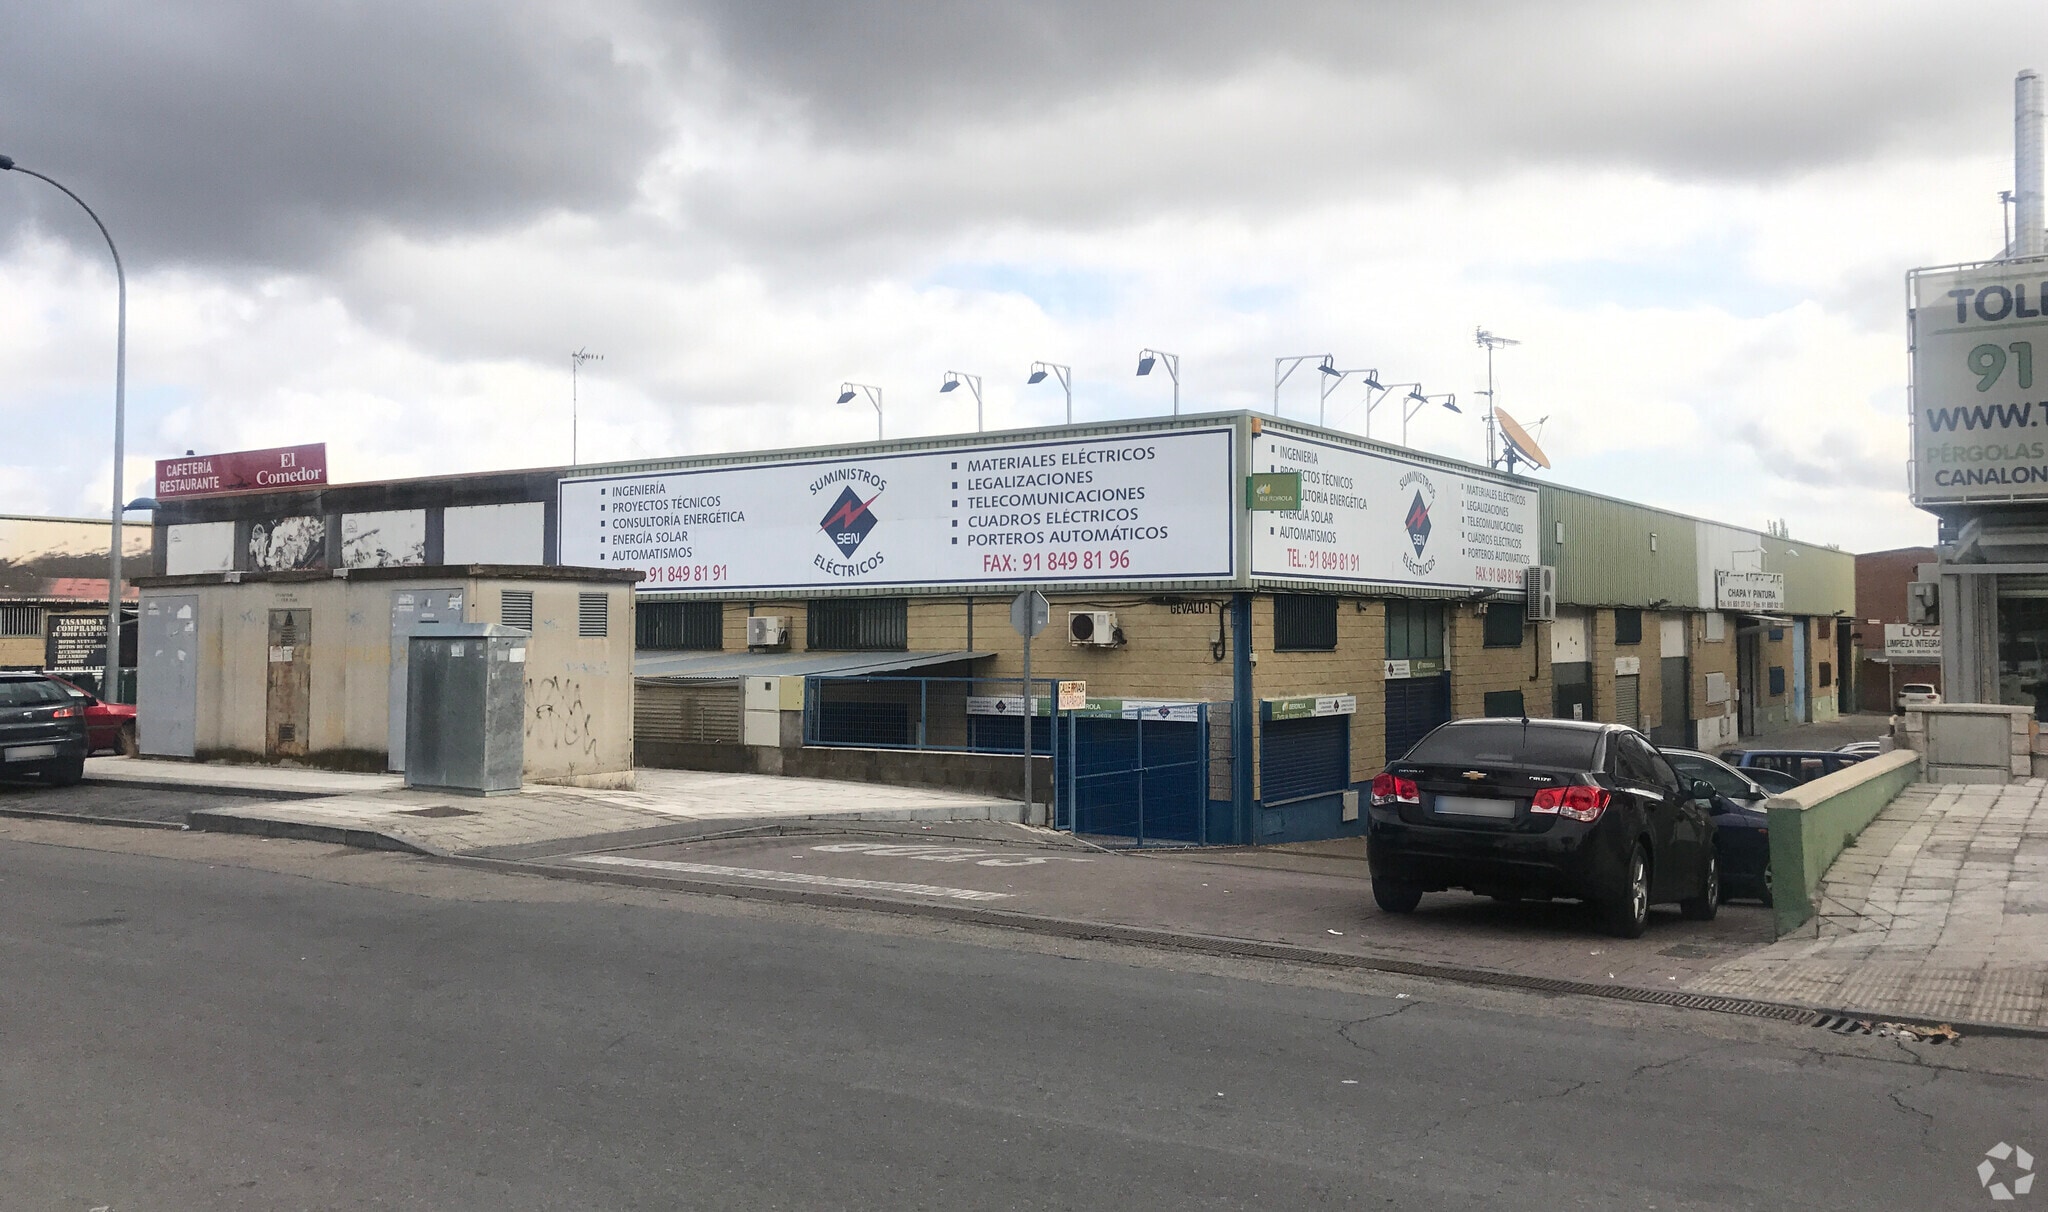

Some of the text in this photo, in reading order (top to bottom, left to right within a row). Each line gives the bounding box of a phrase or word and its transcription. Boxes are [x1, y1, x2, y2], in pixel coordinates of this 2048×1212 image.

[1948, 281, 2048, 324] TOL
[1968, 342, 2032, 392] 91
[280, 453, 295, 468] El
[968, 447, 1155, 472] MATERIALES ELÉCTRICOS
[1280, 446, 1318, 464] INGENIERÍA
[1928, 442, 2044, 464] PÉRGOLAS
[166, 459, 212, 477] CAFETERÍA
[257, 467, 322, 485] Comedor
[160, 476, 219, 493] RESTAURANTE
[810, 468, 887, 495] SUMINISTROS
[968, 471, 1093, 490] LEGALIZACIONES
[1322, 470, 1353, 489] TÉCNICOS
[1400, 471, 1435, 499] SUMINISTROS
[612, 481, 666, 497] INGENIERÍA
[968, 487, 1145, 509] TELECOMUNICACIONES
[1467, 484, 1497, 500] MATERIALES
[612, 496, 721, 513] PROYECTOS TÉCNICOS
[1330, 493, 1367, 510] ENERGÉTICA
[1467, 500, 1508, 516] LEGALIZACIONES
[612, 510, 745, 529] CONSULTORÍA ENERGÉTICA
[968, 508, 1138, 528] CUADROS ELÉCTRICOS
[1280, 506, 1333, 524] ENERGÍA SOLAR
[1467, 516, 1523, 534] TELECOMUNICACIONES
[612, 530, 688, 545] ENERGÍA SOLAR
[837, 533, 860, 544] SEN
[968, 525, 1168, 546] PORTEROS AUTOMÁTICOS
[1280, 526, 1336, 543] AUTOMATISMOS
[1413, 534, 1424, 546] SEN
[1468, 532, 1492, 545] CUADROS
[612, 547, 692, 561] AUTOMATISMOS
[984, 550, 1130, 572] FAX: 91 849 81 96
[1287, 548, 1360, 571] TEL.: 91 849 81 91
[1468, 548, 1494, 560] PORTEROS
[650, 567, 663, 582] 91
[668, 565, 690, 582] 849
[694, 565, 708, 581] 81
[713, 564, 727, 580] 91
[814, 552, 884, 577] ELÉCTRICOS
[1402, 552, 1435, 576] ELÉCTRICOS
[1476, 566, 1522, 584] FAX: 91 849 81 96
[1728, 589, 1776, 599] CHAPA Y PINTURA
